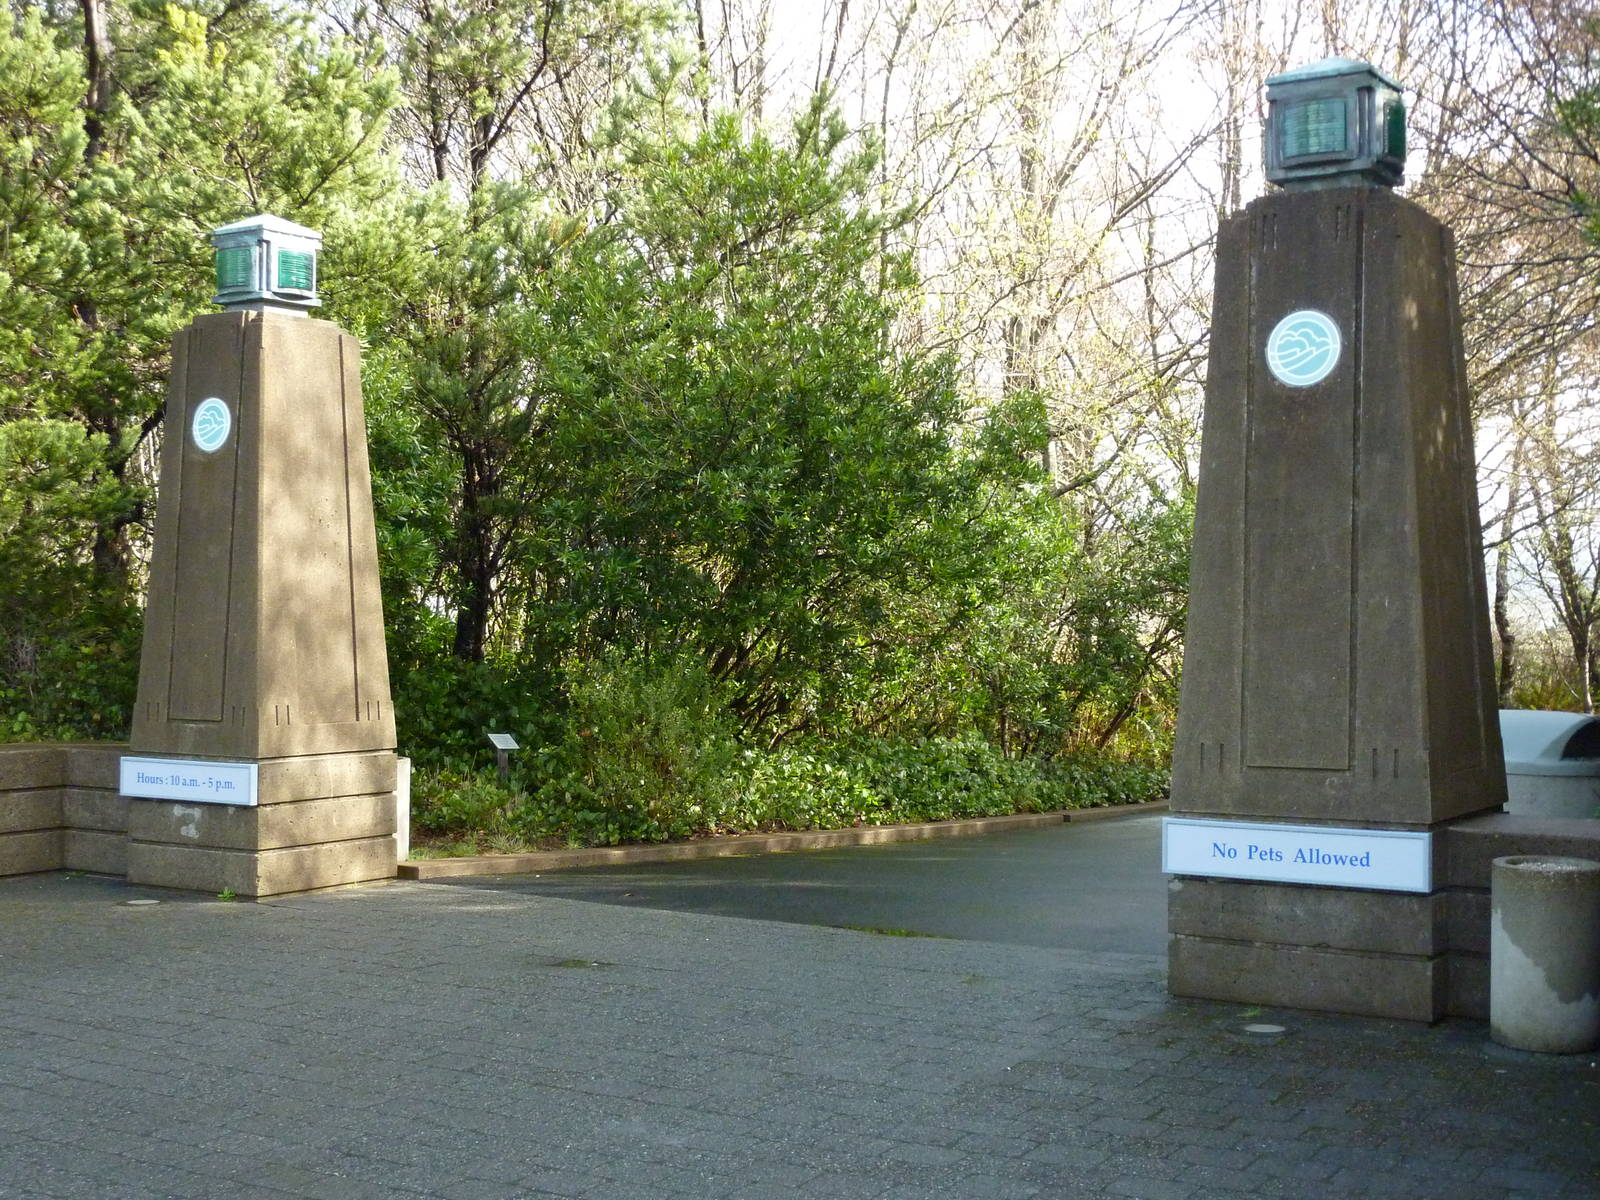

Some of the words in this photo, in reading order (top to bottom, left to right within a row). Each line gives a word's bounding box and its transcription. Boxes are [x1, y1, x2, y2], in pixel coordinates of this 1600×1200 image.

[170, 775, 180, 786] 10
[182, 777, 201, 787] a.m.
[208, 777, 214, 788] 5
[215, 780, 236, 792] p.m.
[1211, 842, 1237, 859] No
[1247, 844, 1283, 862] Pets
[1293, 848, 1370, 867] Allowed
